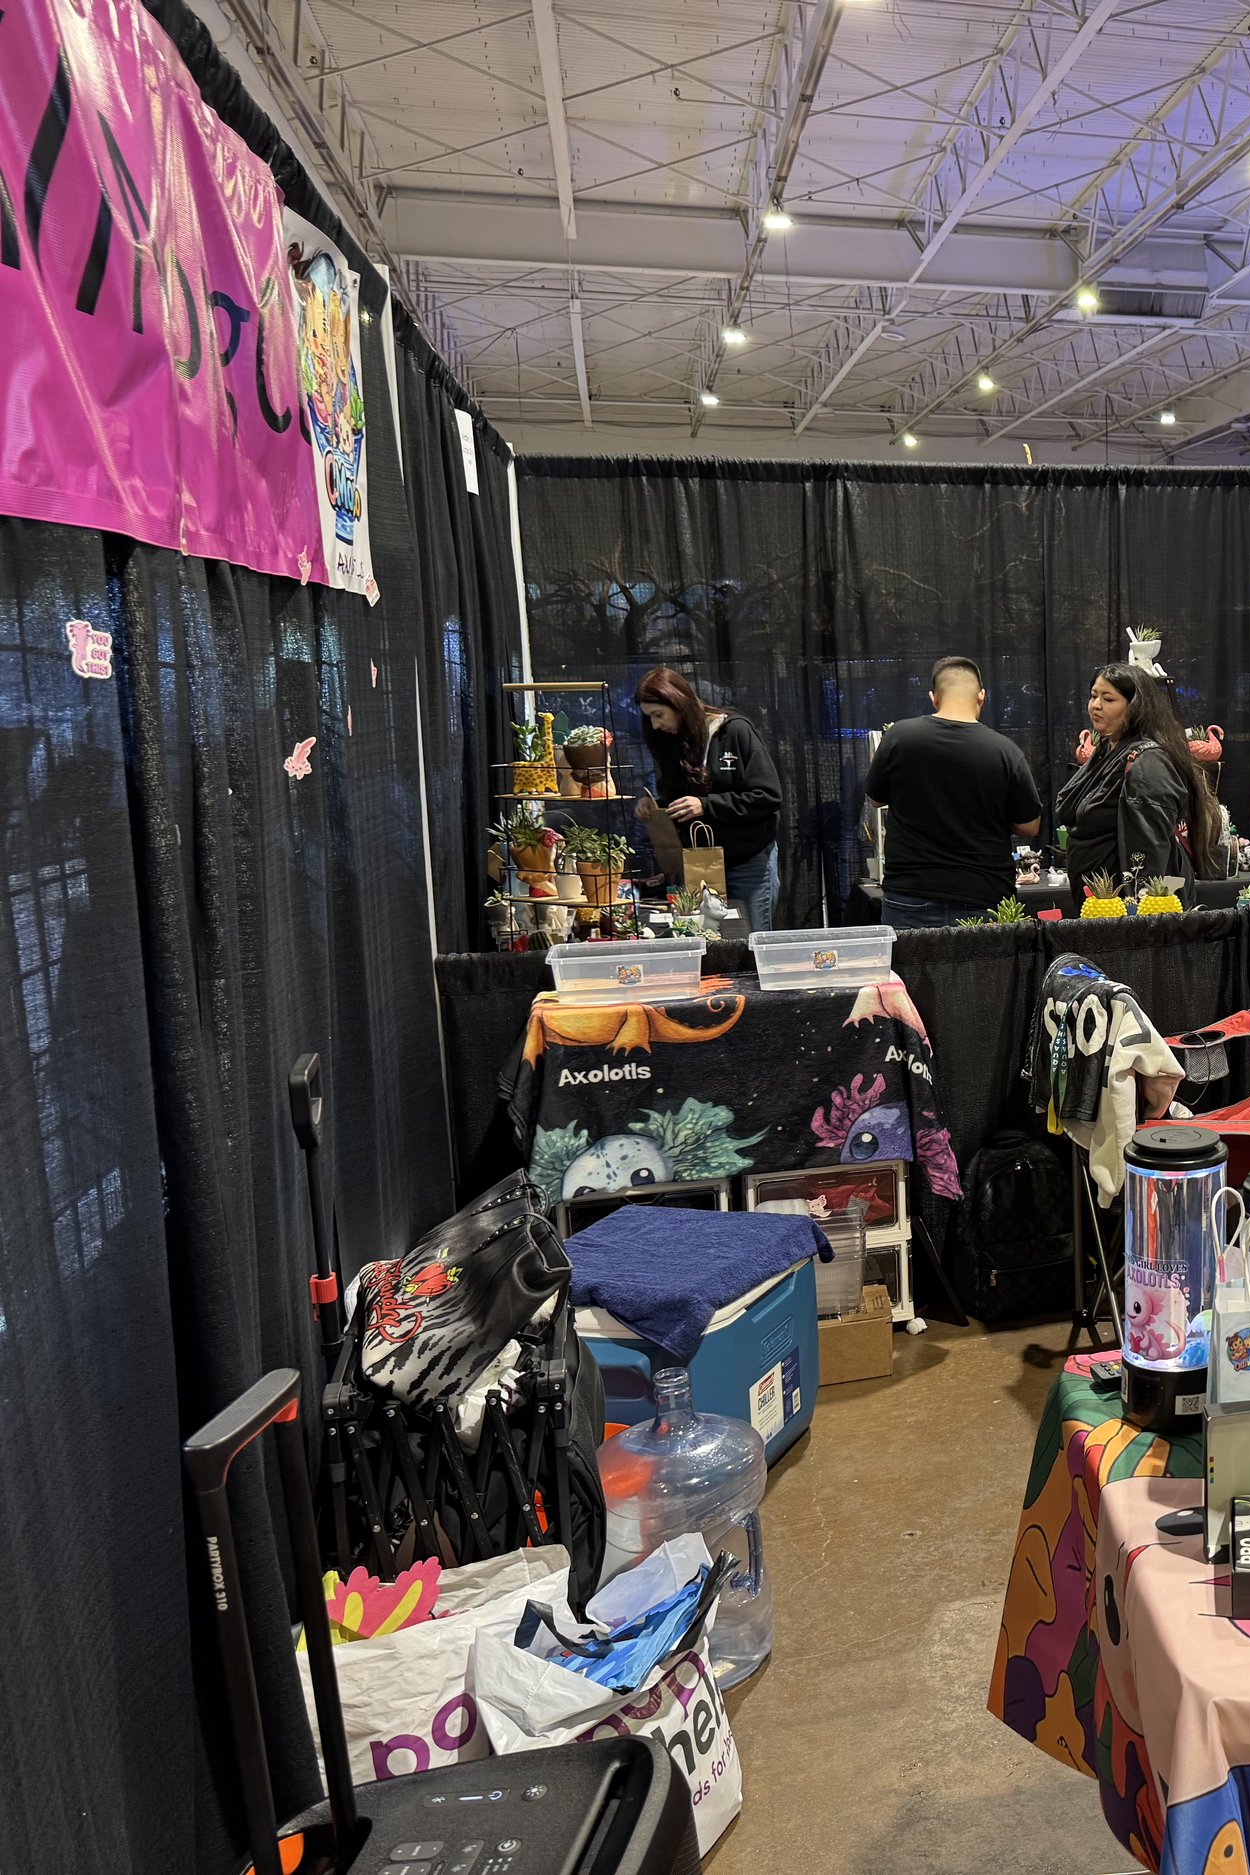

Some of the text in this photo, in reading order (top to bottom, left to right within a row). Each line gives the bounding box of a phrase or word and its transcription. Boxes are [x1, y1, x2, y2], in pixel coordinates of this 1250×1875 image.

[558, 1063, 652, 1087] Axolotls
[1127, 1266, 1180, 1289] AXOLOTLS
[1156, 1263, 1189, 1273] LOVES
[206, 1535, 229, 1611] PARTYBOX 310
